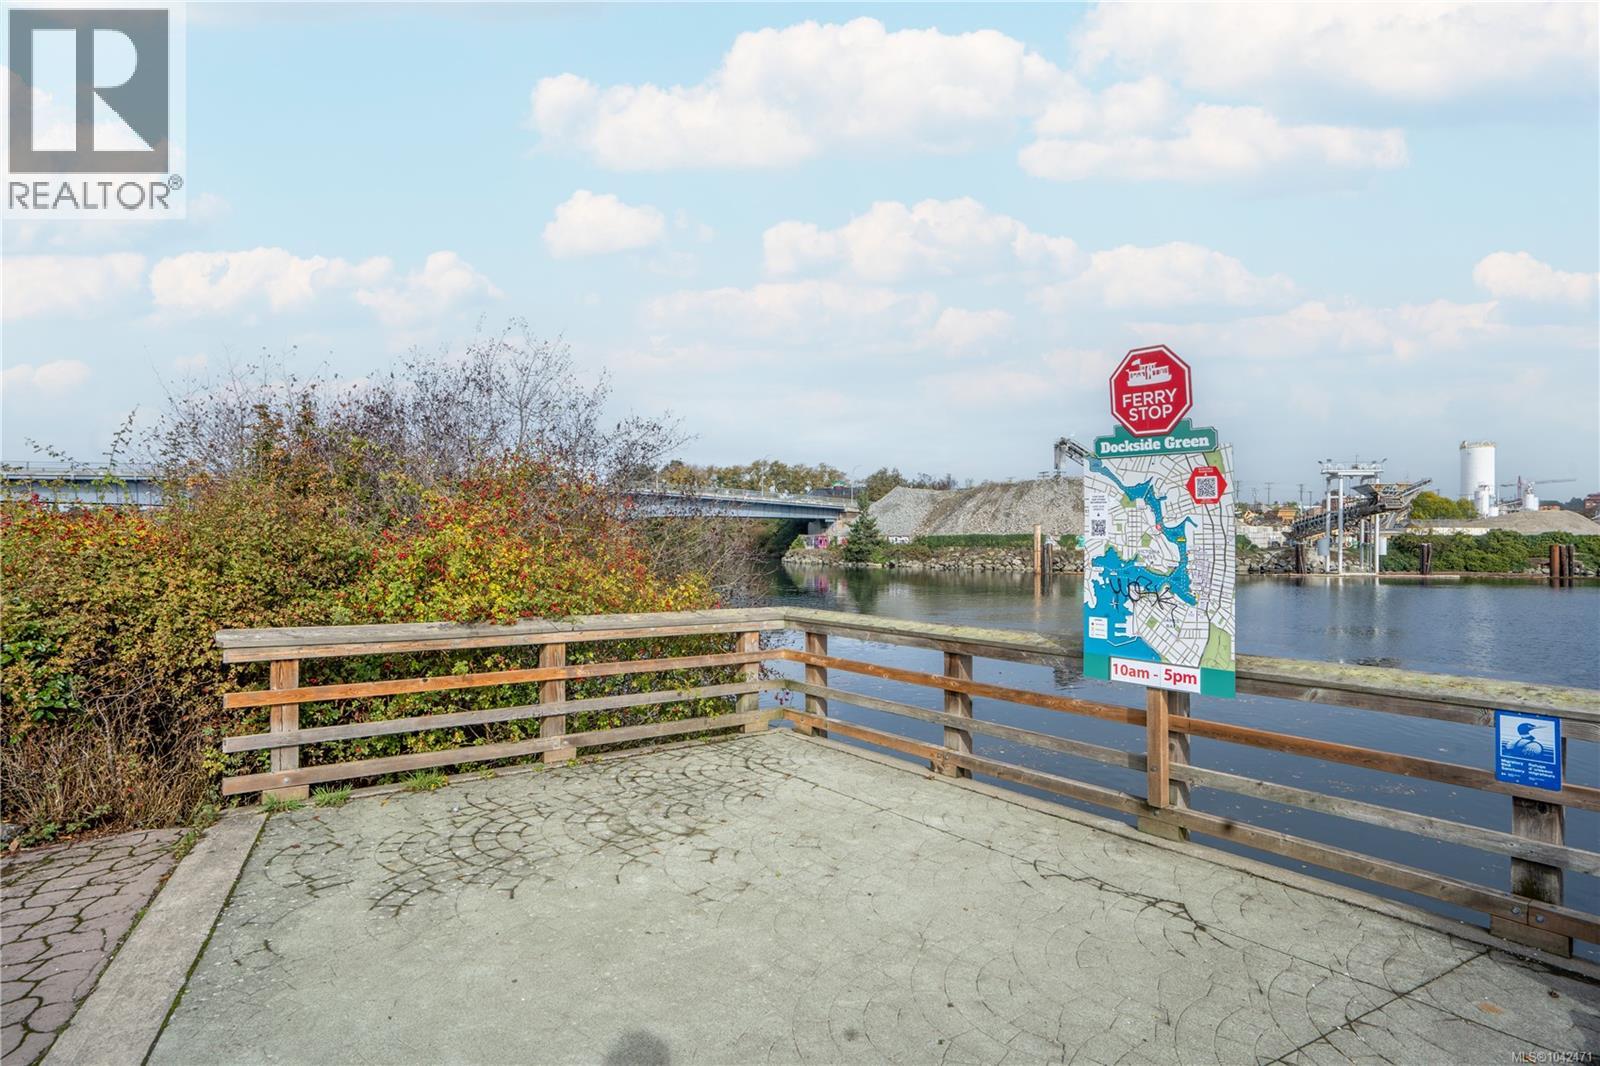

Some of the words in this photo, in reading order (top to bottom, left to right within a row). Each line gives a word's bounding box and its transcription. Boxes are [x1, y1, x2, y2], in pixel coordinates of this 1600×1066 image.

[1122, 388, 1178, 408] FERRY
[1128, 404, 1173, 421] STOP
[1100, 438, 1161, 454] Dockside
[1164, 436, 1210, 449] Green
[1112, 663, 1150, 680] 10am
[1164, 668, 1198, 685] 5pm
